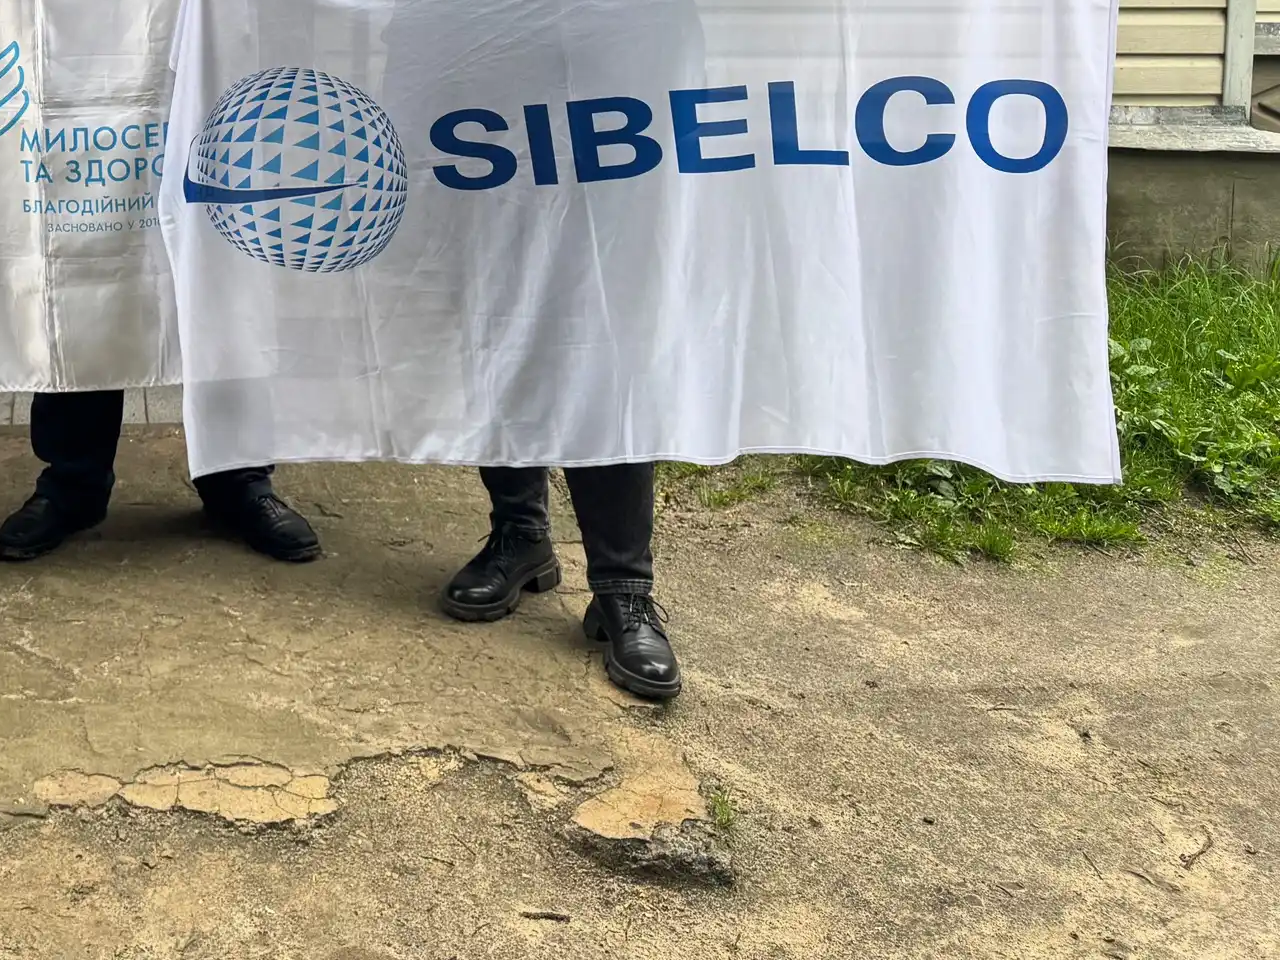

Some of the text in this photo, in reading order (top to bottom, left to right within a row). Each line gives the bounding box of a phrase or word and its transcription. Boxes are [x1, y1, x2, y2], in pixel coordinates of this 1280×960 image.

[429, 76, 1069, 192] SIBELCO
[19, 159, 53, 183] ТА
[22, 191, 154, 216] БЛАГОДІЙНИЙ
[47, 221, 123, 233] ЗАСНОВАНО
[127, 220, 135, 230] У
